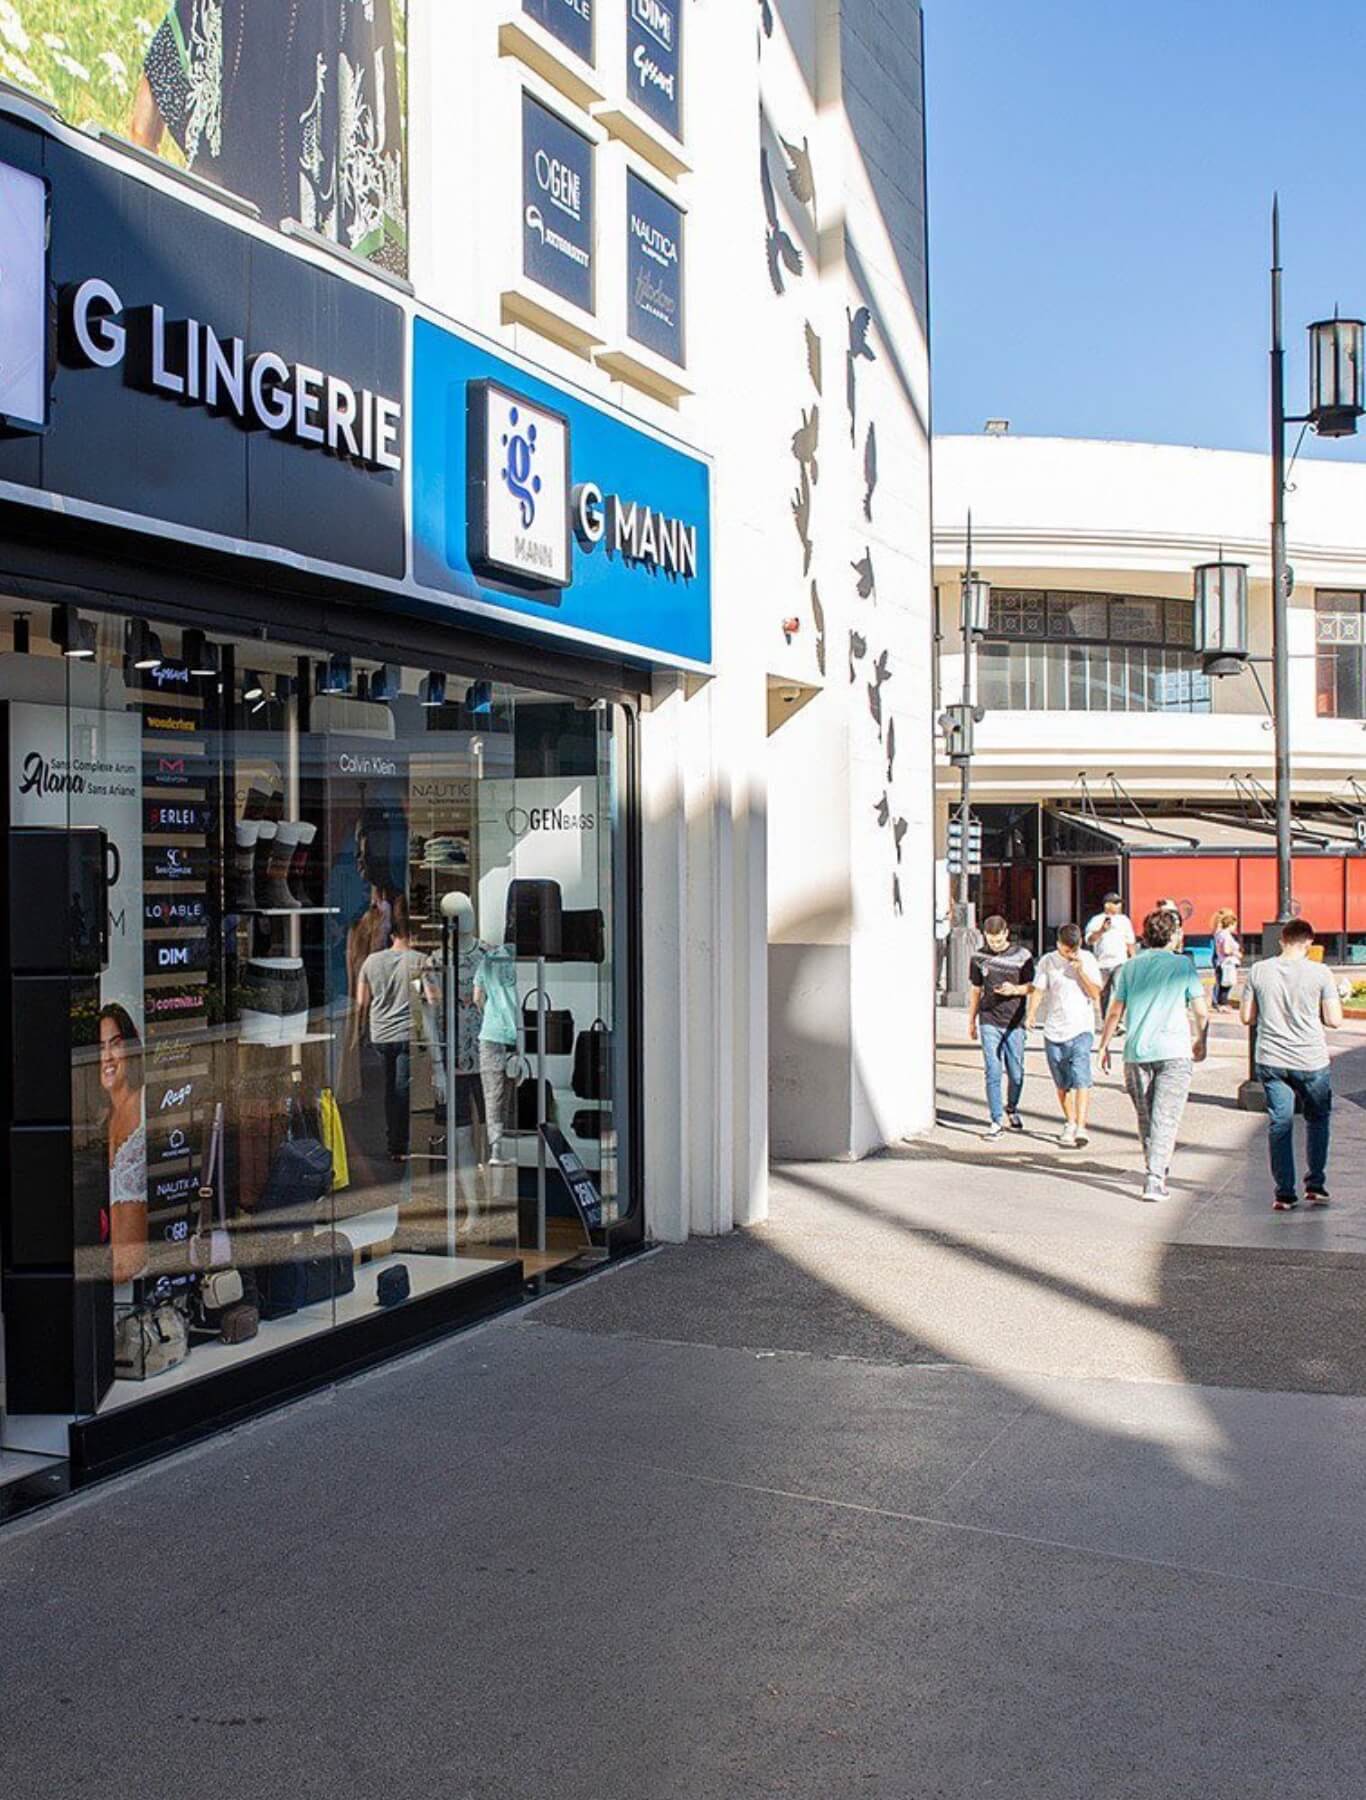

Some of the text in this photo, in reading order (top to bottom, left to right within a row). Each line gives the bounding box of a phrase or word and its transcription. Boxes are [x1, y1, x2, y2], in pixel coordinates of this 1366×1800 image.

[631, 214, 678, 263] NAUTICA
[72, 278, 402, 472] G LINGERIE
[514, 536, 554, 568] MANN
[580, 482, 697, 578] G MANN
[18, 751, 86, 798] Alana
[340, 753, 397, 776] Calvin Klein
[158, 948, 188, 965] DIM
